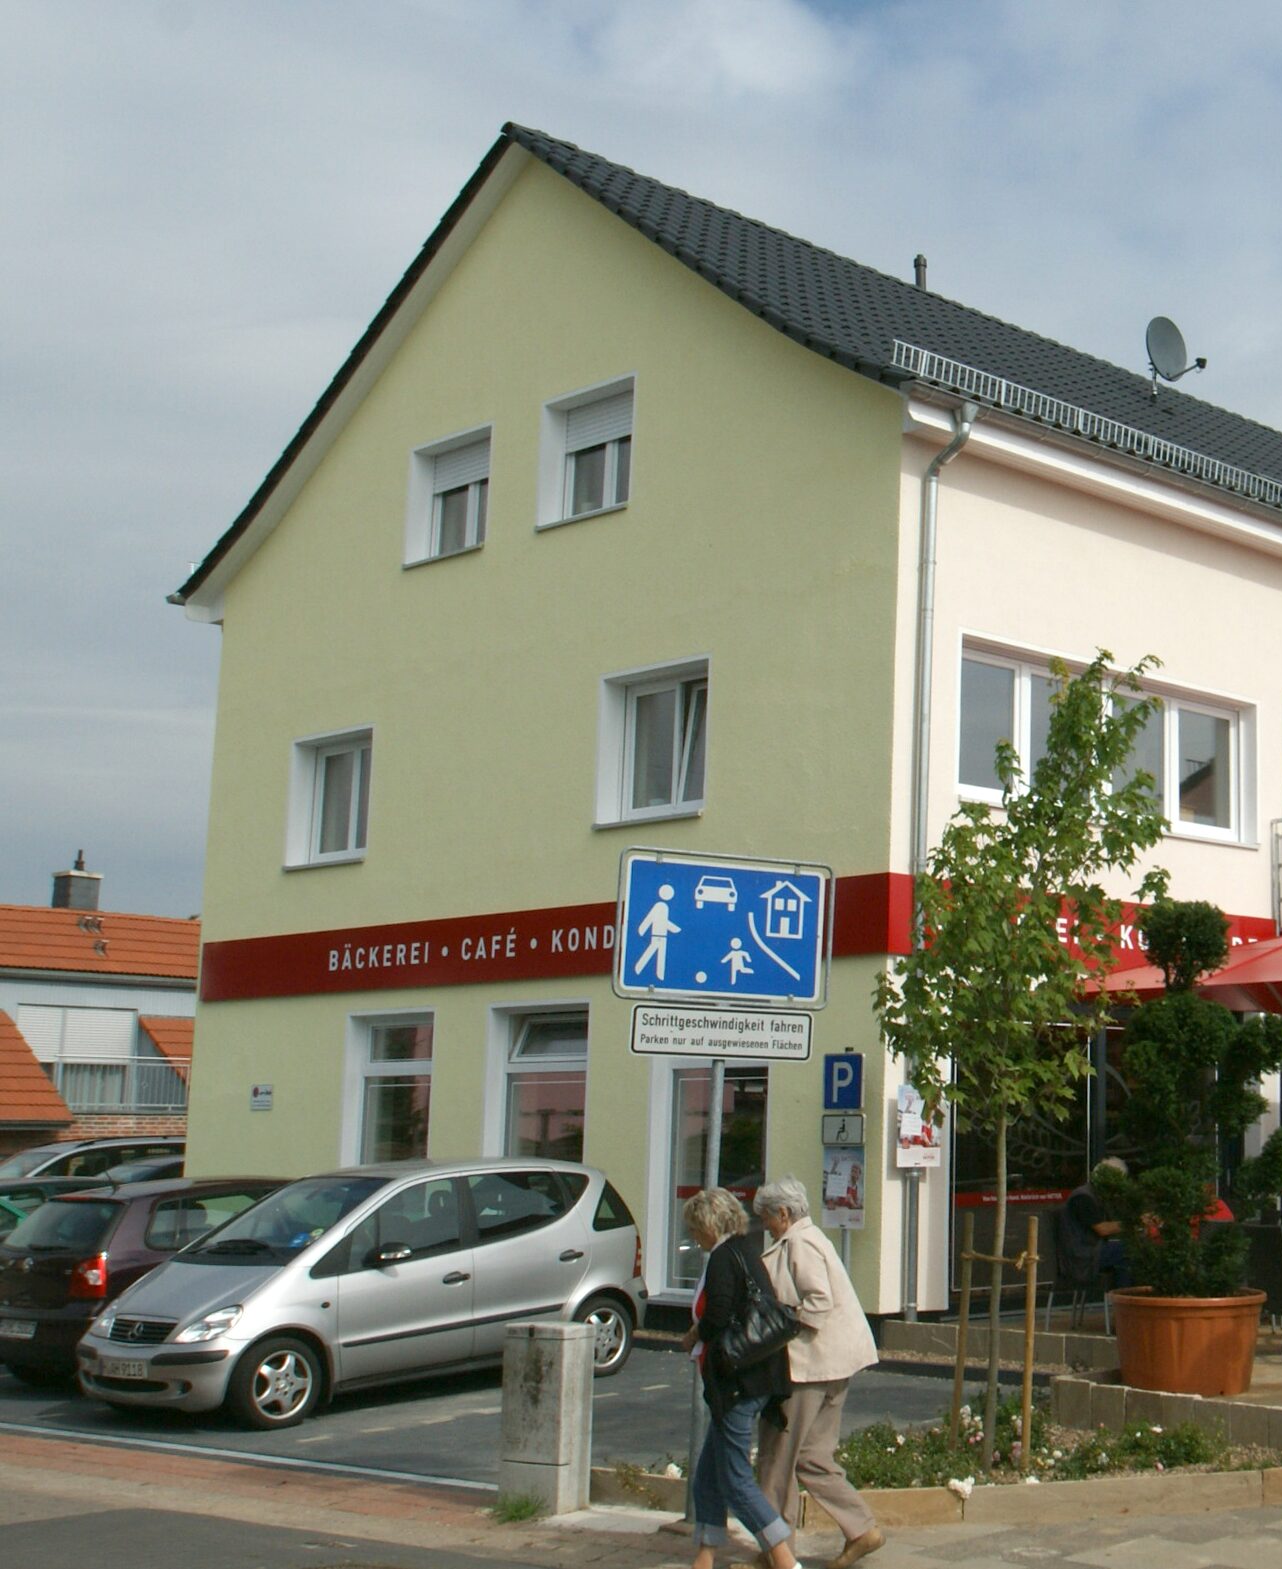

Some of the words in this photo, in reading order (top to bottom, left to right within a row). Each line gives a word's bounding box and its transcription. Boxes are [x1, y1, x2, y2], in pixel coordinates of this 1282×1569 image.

[328, 942, 429, 972] BÄCKEREI
[461, 928, 517, 960] CAFÉ
[551, 924, 615, 953] KOND
[641, 1012, 765, 1034] Schrittgeschwindigkeit
[770, 1020, 804, 1034] fahren
[640, 1033, 669, 1045] Parken
[672, 1037, 686, 1046] nur
[690, 1036, 704, 1047] auf
[708, 1038, 769, 1049] ausgewiesenen
[772, 1039, 803, 1051] Flächen
[832, 1061, 853, 1103] P
